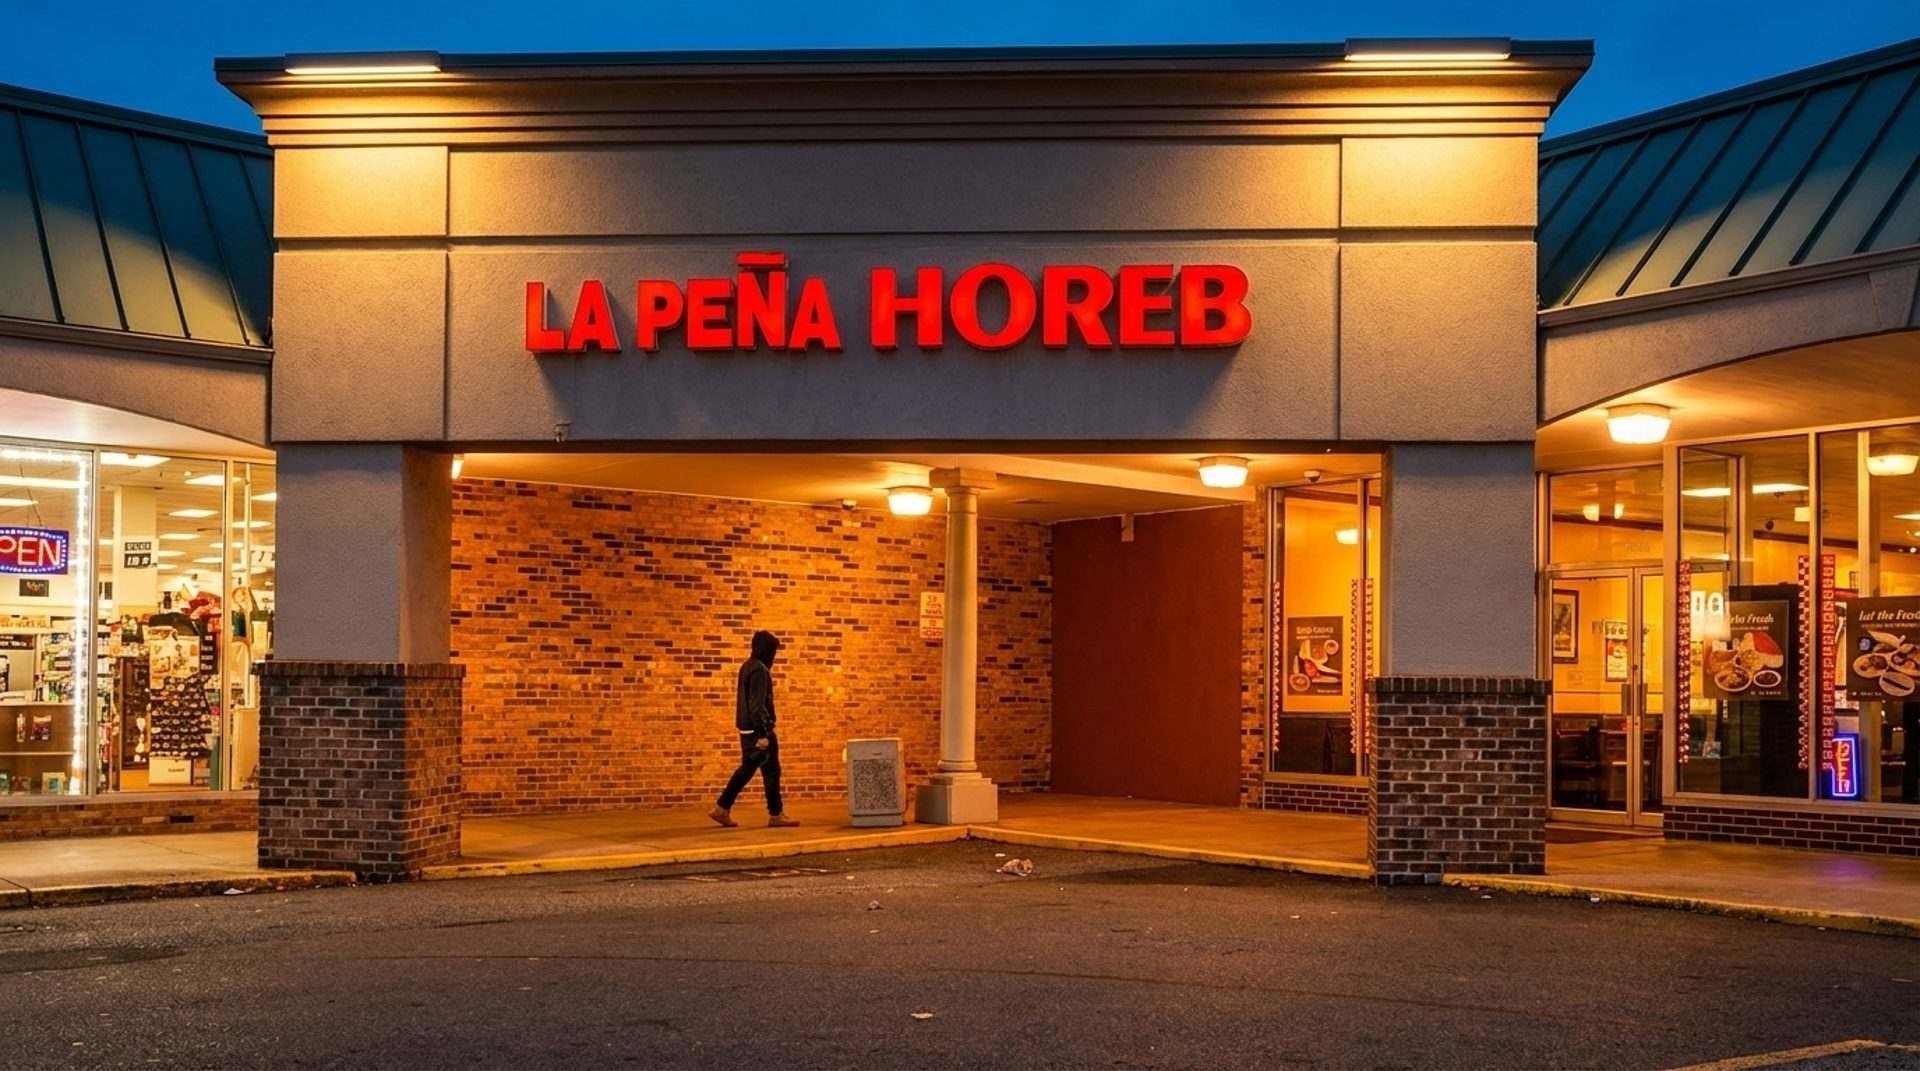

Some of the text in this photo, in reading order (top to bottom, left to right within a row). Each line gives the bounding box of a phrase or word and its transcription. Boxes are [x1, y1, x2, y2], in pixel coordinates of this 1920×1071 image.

[525, 252, 1253, 351] LA PEÑA HOREB
